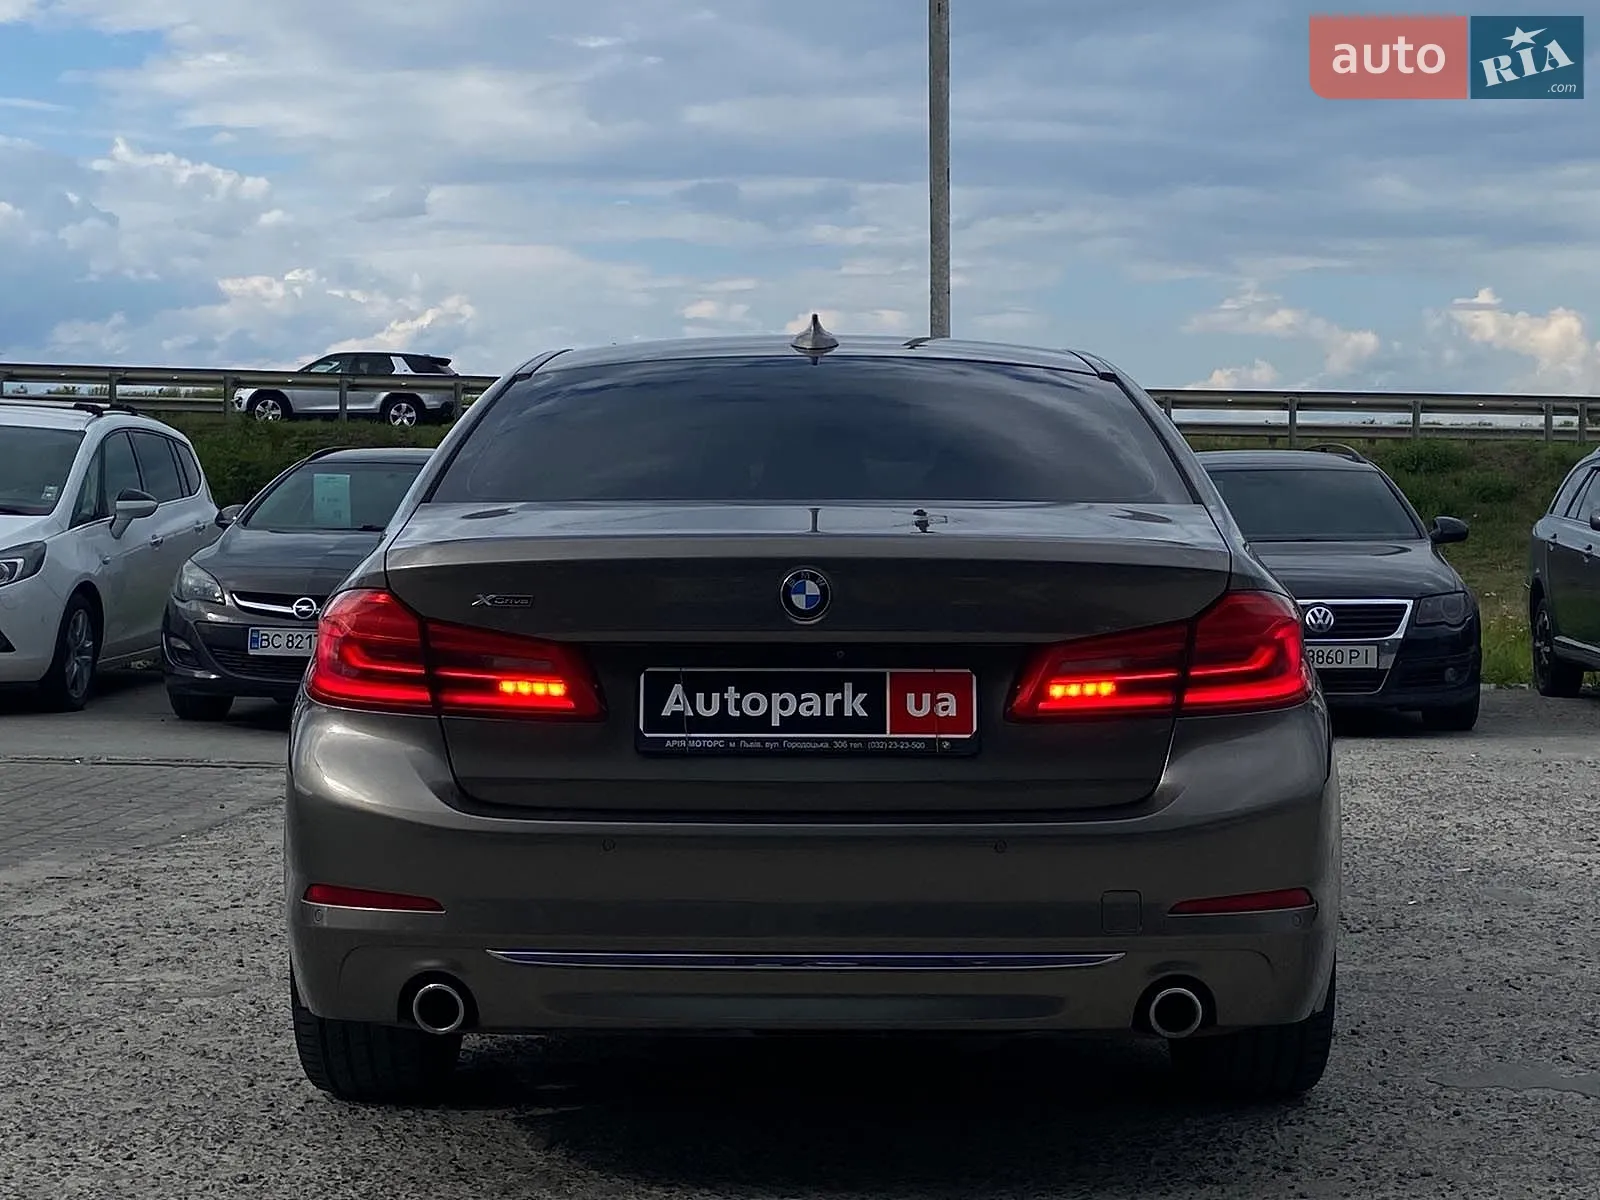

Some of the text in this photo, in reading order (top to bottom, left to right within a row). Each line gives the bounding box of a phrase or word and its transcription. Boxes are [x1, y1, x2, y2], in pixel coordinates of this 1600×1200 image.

[260, 633, 282, 649] BC
[286, 634, 318, 649] 821
[661, 682, 957, 727] Autopark ua
